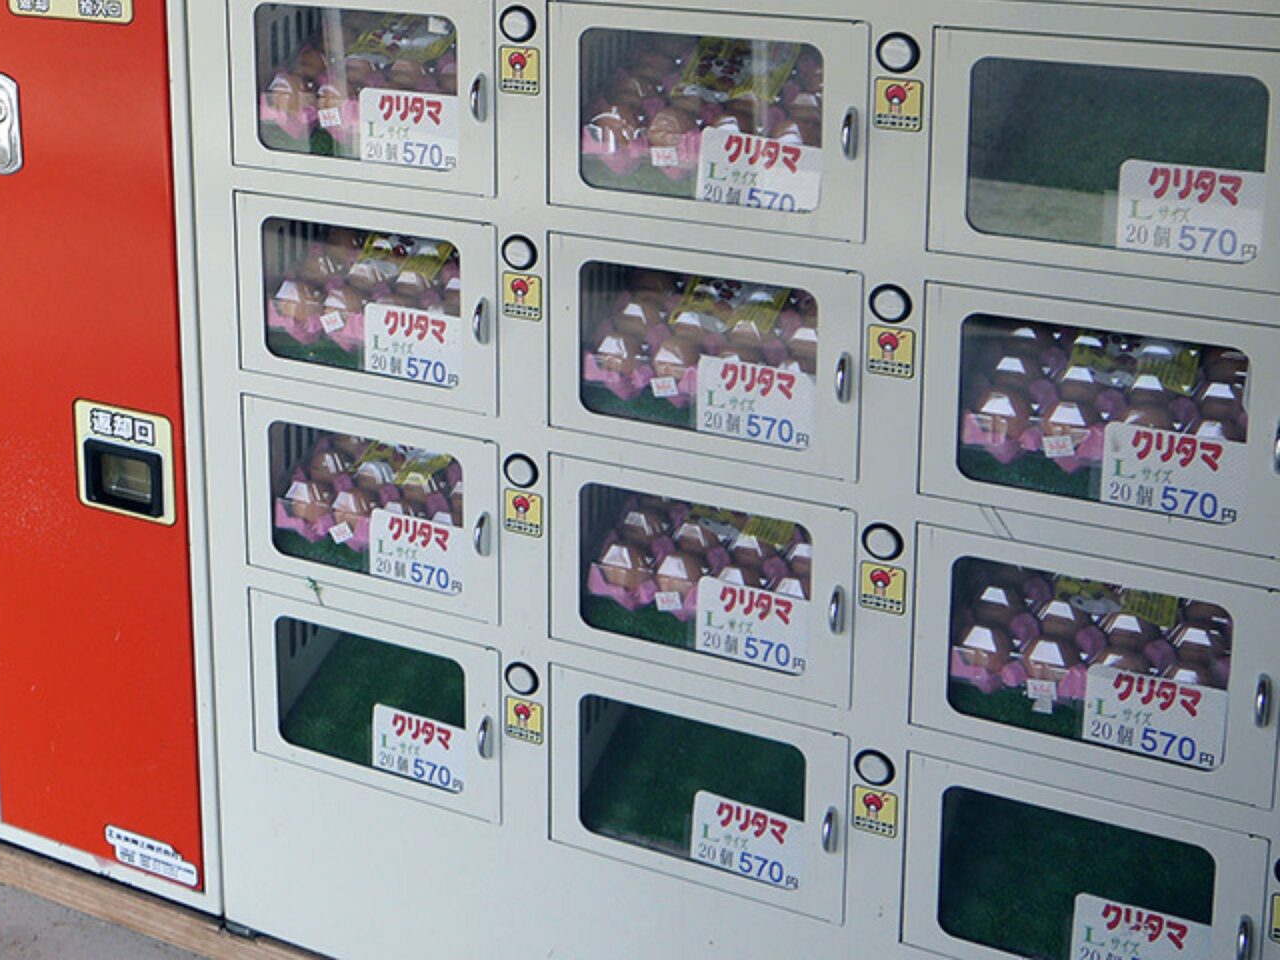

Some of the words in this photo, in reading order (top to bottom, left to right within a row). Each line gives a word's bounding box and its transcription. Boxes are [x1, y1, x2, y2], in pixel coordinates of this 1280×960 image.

[379, 96, 442, 125] クリタマ
[367, 143, 398, 161] 20個
[403, 142, 456, 168] 570円
[726, 135, 801, 173] クリタマ
[747, 188, 810, 213] 570
[1149, 168, 1242, 206] クリタマ
[1131, 200, 1190, 222] Lサイズ
[1126, 225, 1171, 248] 20個
[1179, 226, 1257, 258] 570円
[384, 311, 446, 343] クリタマ
[371, 355, 402, 375] 20個
[407, 358, 458, 386] 570円
[722, 364, 795, 399] クリタマ
[90, 408, 154, 446] 返却口
[704, 411, 740, 434] 20個
[746, 415, 809, 446] 570円
[1132, 430, 1222, 472] クリタマ
[1113, 459, 1172, 484] Lサイズ
[1110, 482, 1153, 507] 20個
[1161, 486, 1237, 522] 570円
[389, 517, 449, 551] クリタマ
[376, 558, 406, 578] 20個
[411, 563, 462, 592] 570円
[720, 586, 792, 624] クリタマ
[703, 631, 738, 654] 20個
[744, 637, 806, 670] 570円
[1094, 698, 1152, 725] Lサイズ
[1114, 673, 1201, 717] クリタマ
[392, 714, 451, 750] クリタマ
[1091, 720, 1133, 745] 20個
[1141, 728, 1214, 766] 570円
[379, 752, 408, 773] 20個
[413, 758, 464, 792] 570円
[717, 802, 788, 844] クリタマ
[698, 845, 733, 868] 20個
[738, 852, 799, 890] 570円
[1085, 926, 1139, 954] Lサイズ
[1103, 904, 1188, 950] クリタマ
